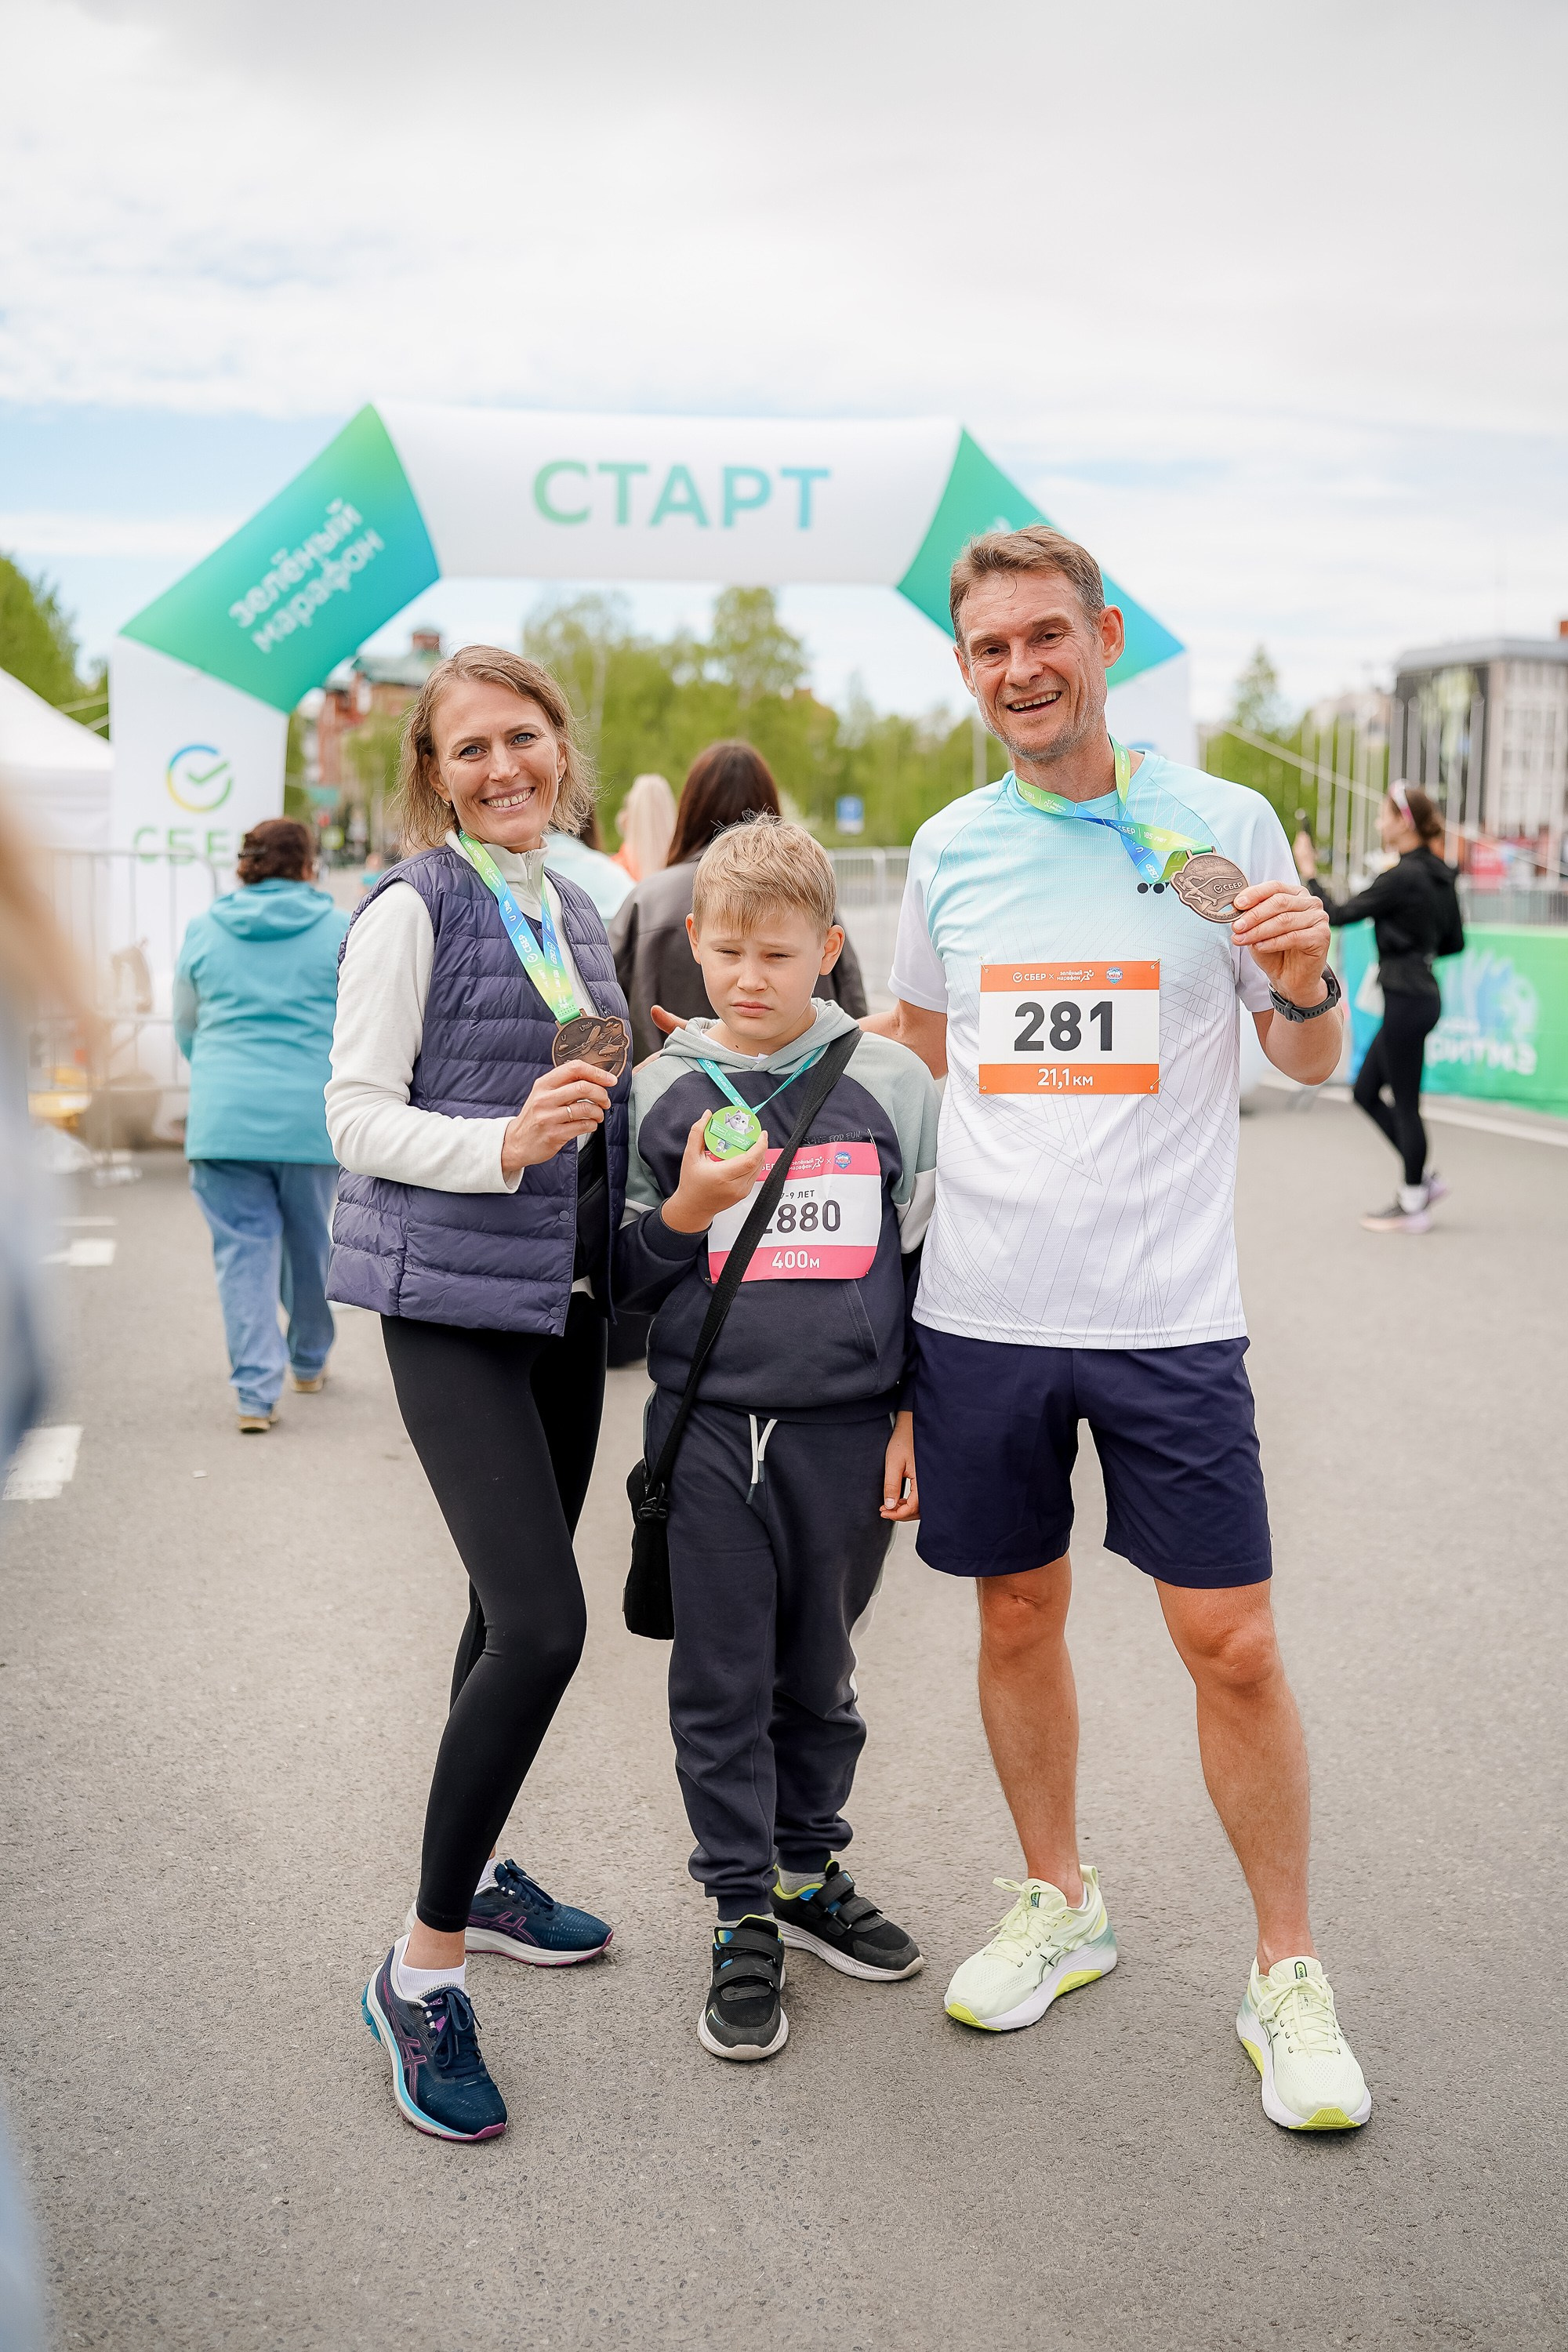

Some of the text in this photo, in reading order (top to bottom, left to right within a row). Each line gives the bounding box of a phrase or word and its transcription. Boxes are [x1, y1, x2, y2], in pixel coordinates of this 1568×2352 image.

[533, 459, 831, 529] СТАРТ
[228, 497, 364, 629] зелёный
[250, 528, 385, 654] марафон
[132, 825, 245, 866] СБЕ
[1145, 863, 1160, 879] СБЕР
[1223, 882, 1243, 891] СБЕР
[518, 935, 532, 954] СБЕР
[1014, 1000, 1112, 1051] 281
[829, 1134, 844, 1142] FOR
[846, 1131, 861, 1141] FUN
[797, 1190, 815, 1199] ЛЕТ
[764, 1200, 840, 1234] 880
